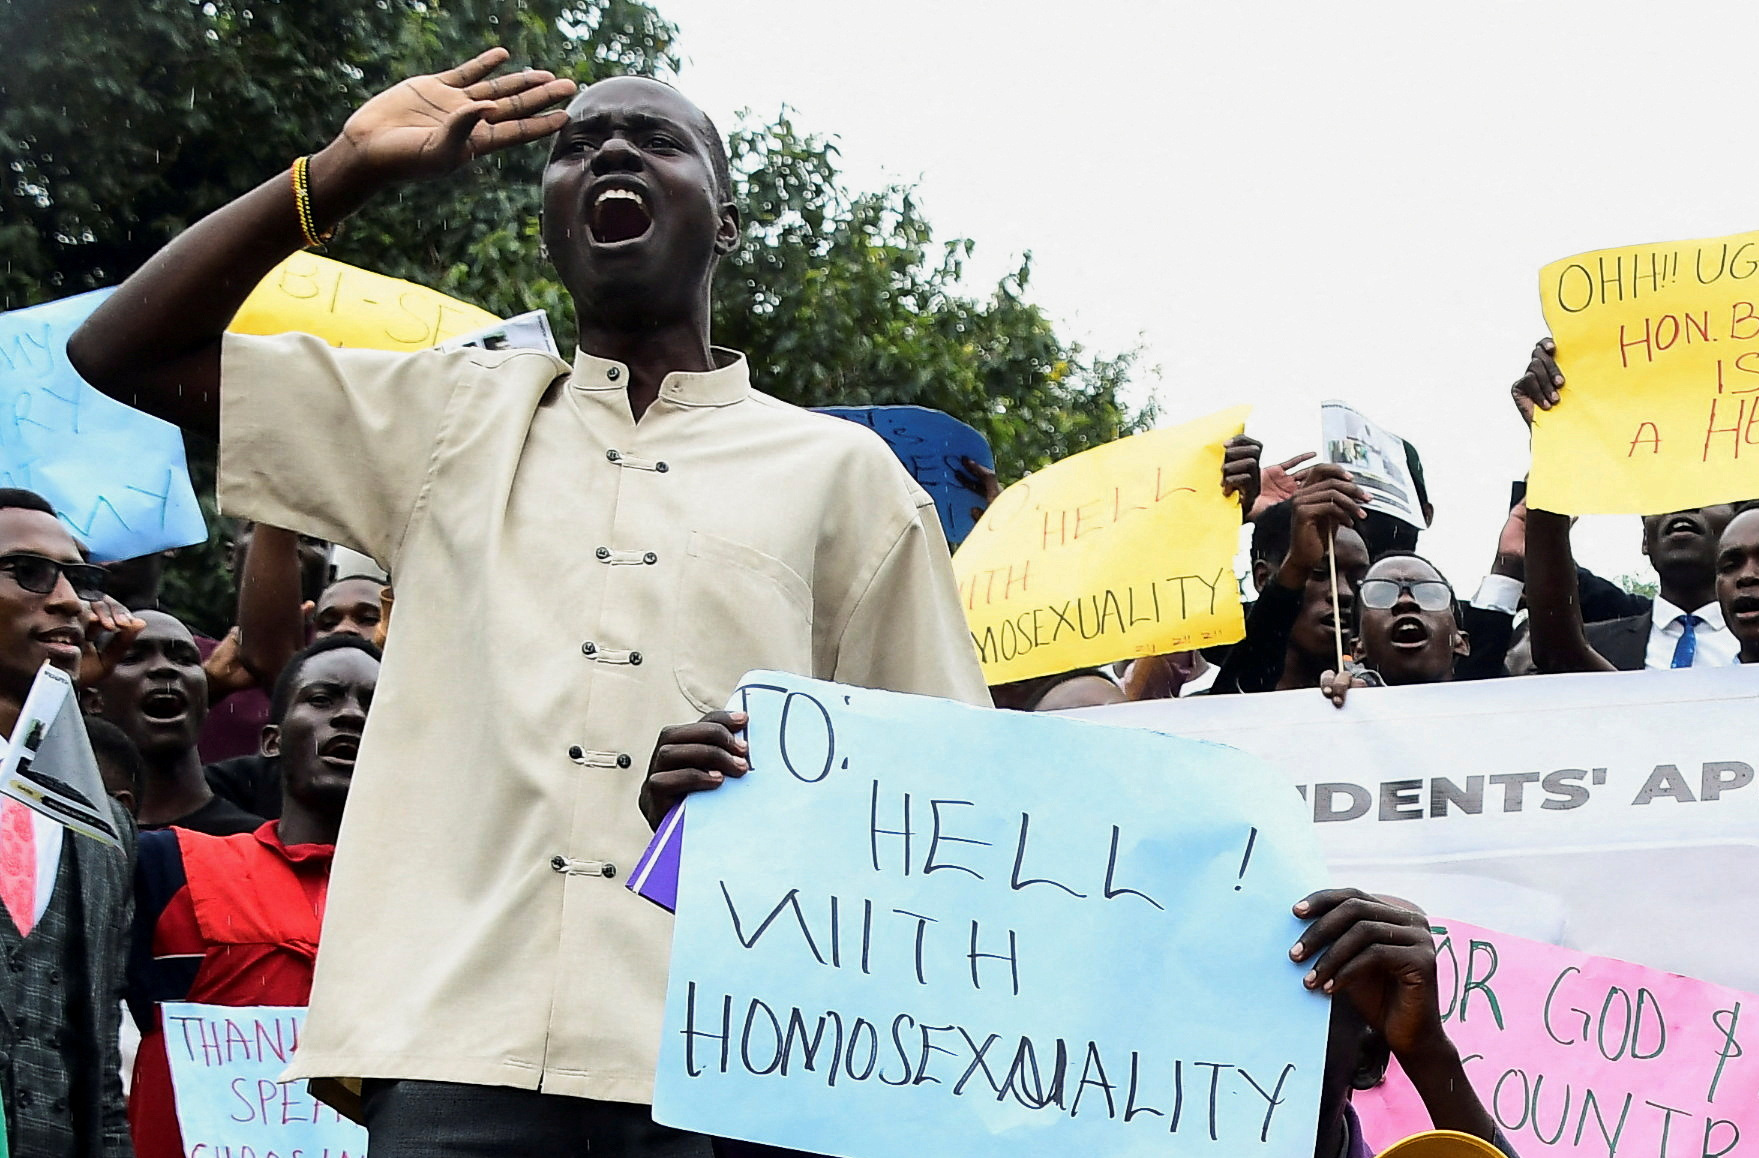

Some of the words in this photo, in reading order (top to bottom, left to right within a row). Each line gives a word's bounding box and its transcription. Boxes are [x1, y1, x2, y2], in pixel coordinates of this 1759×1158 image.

[1618, 310, 1718, 368] HON.
[1628, 421, 1662, 457] A
[1042, 467, 1197, 551] HELL
[1296, 767, 1607, 824] DENTS'
[870, 779, 1164, 911] HELL
[1543, 966, 1666, 1062] GOD
